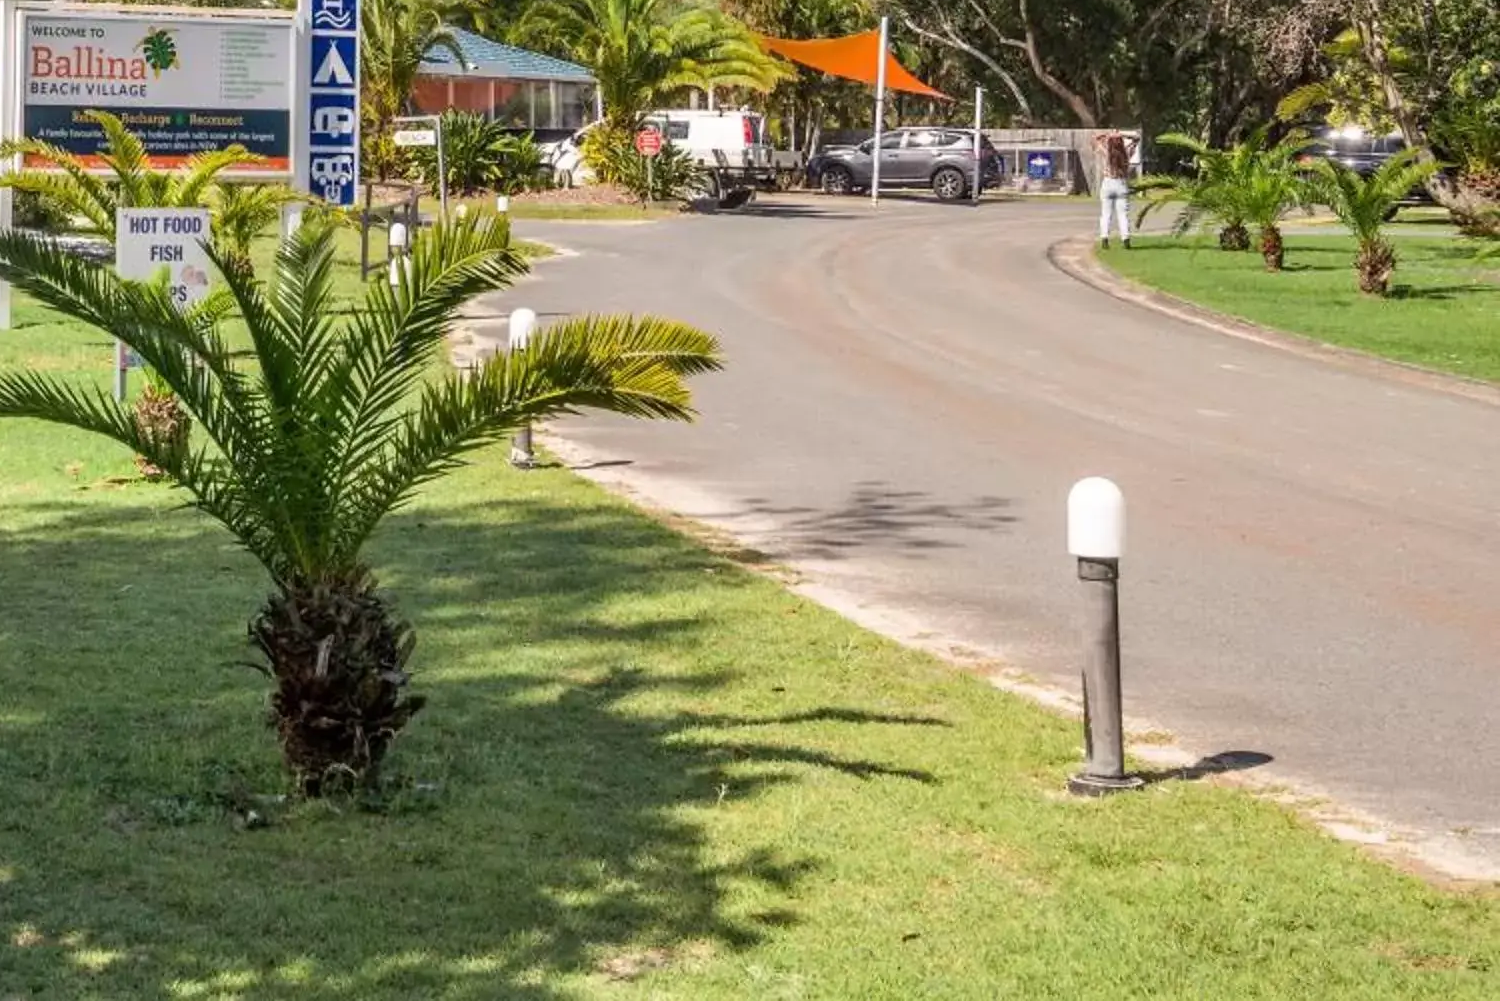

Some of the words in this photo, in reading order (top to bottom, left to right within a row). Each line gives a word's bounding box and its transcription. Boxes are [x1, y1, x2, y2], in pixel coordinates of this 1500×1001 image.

[31, 25, 86, 38] WELCOME
[90, 28, 105, 38] TO
[31, 45, 147, 80] Ballina
[30, 82, 80, 95] BEACH
[85, 83, 147, 97] VILLAGE
[130, 217, 158, 234] HOT
[163, 217, 202, 234] FOOD
[150, 245, 183, 261] FISH
